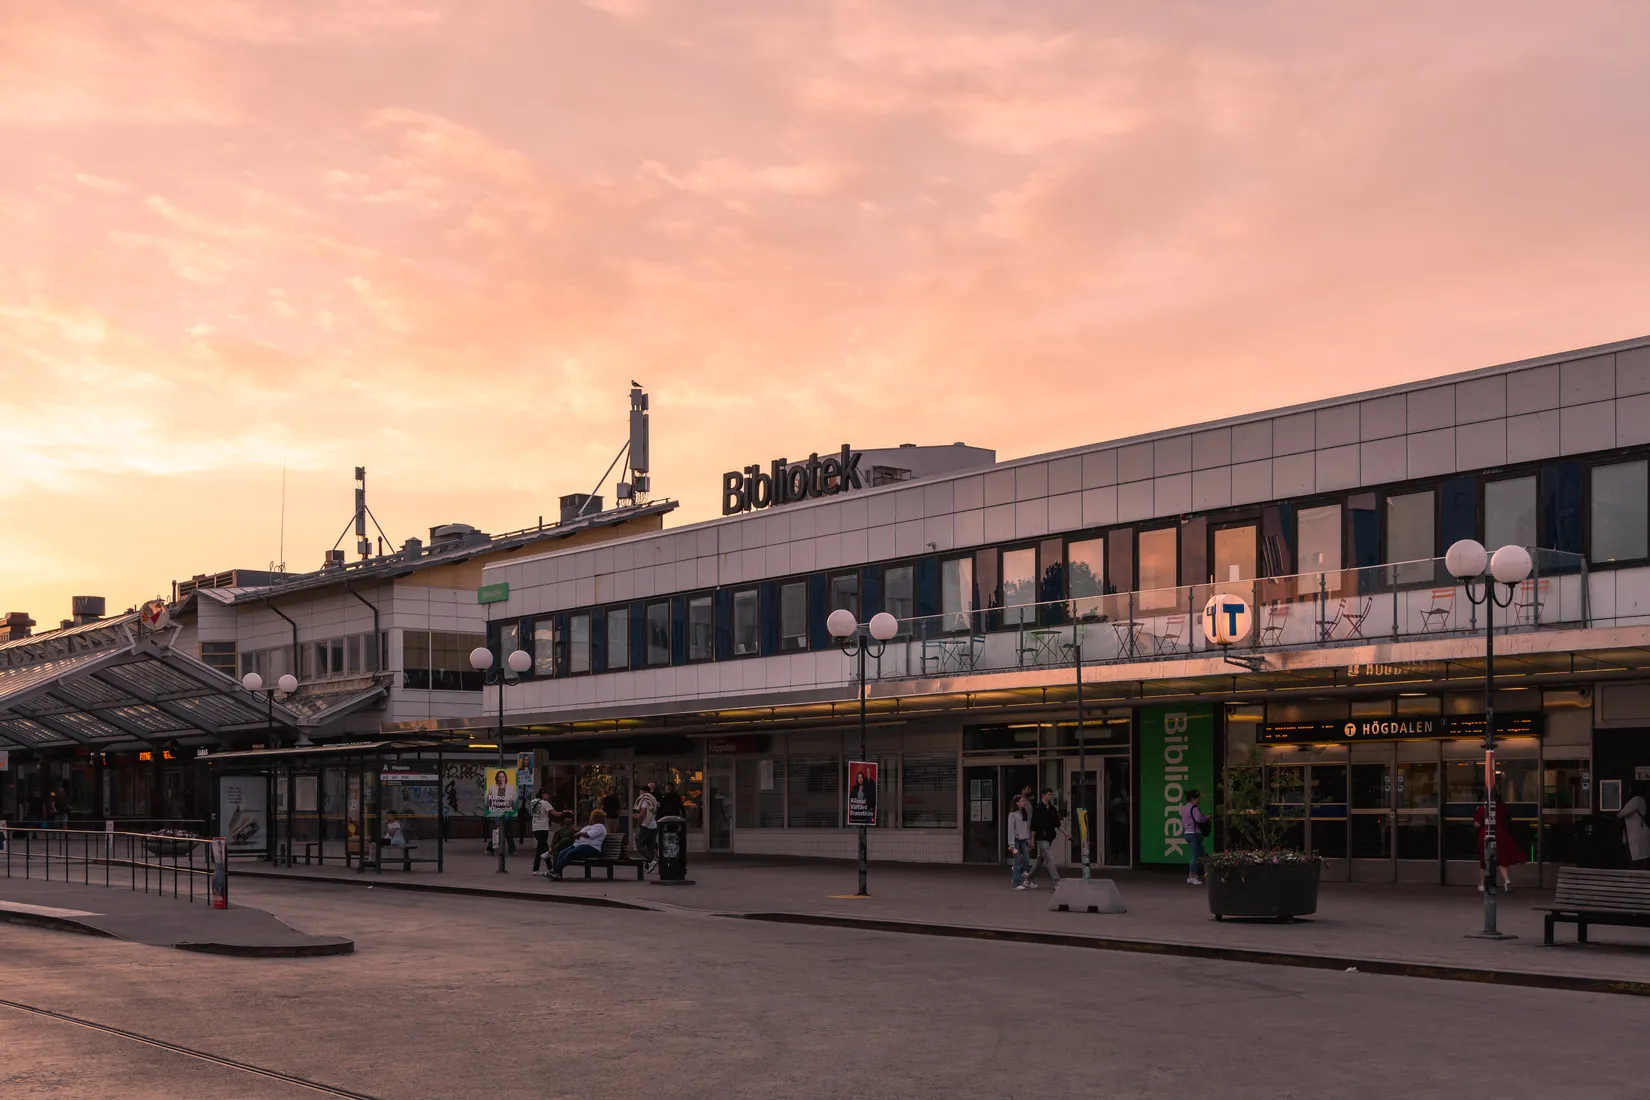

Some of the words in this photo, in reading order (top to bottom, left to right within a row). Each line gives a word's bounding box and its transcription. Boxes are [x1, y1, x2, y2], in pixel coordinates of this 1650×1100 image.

[723, 444, 862, 516] Bibliotek
[1223, 604, 1245, 636] T
[1362, 721, 1434, 736] HÖGDALEN
[1164, 712, 1189, 857] Bibliotek
